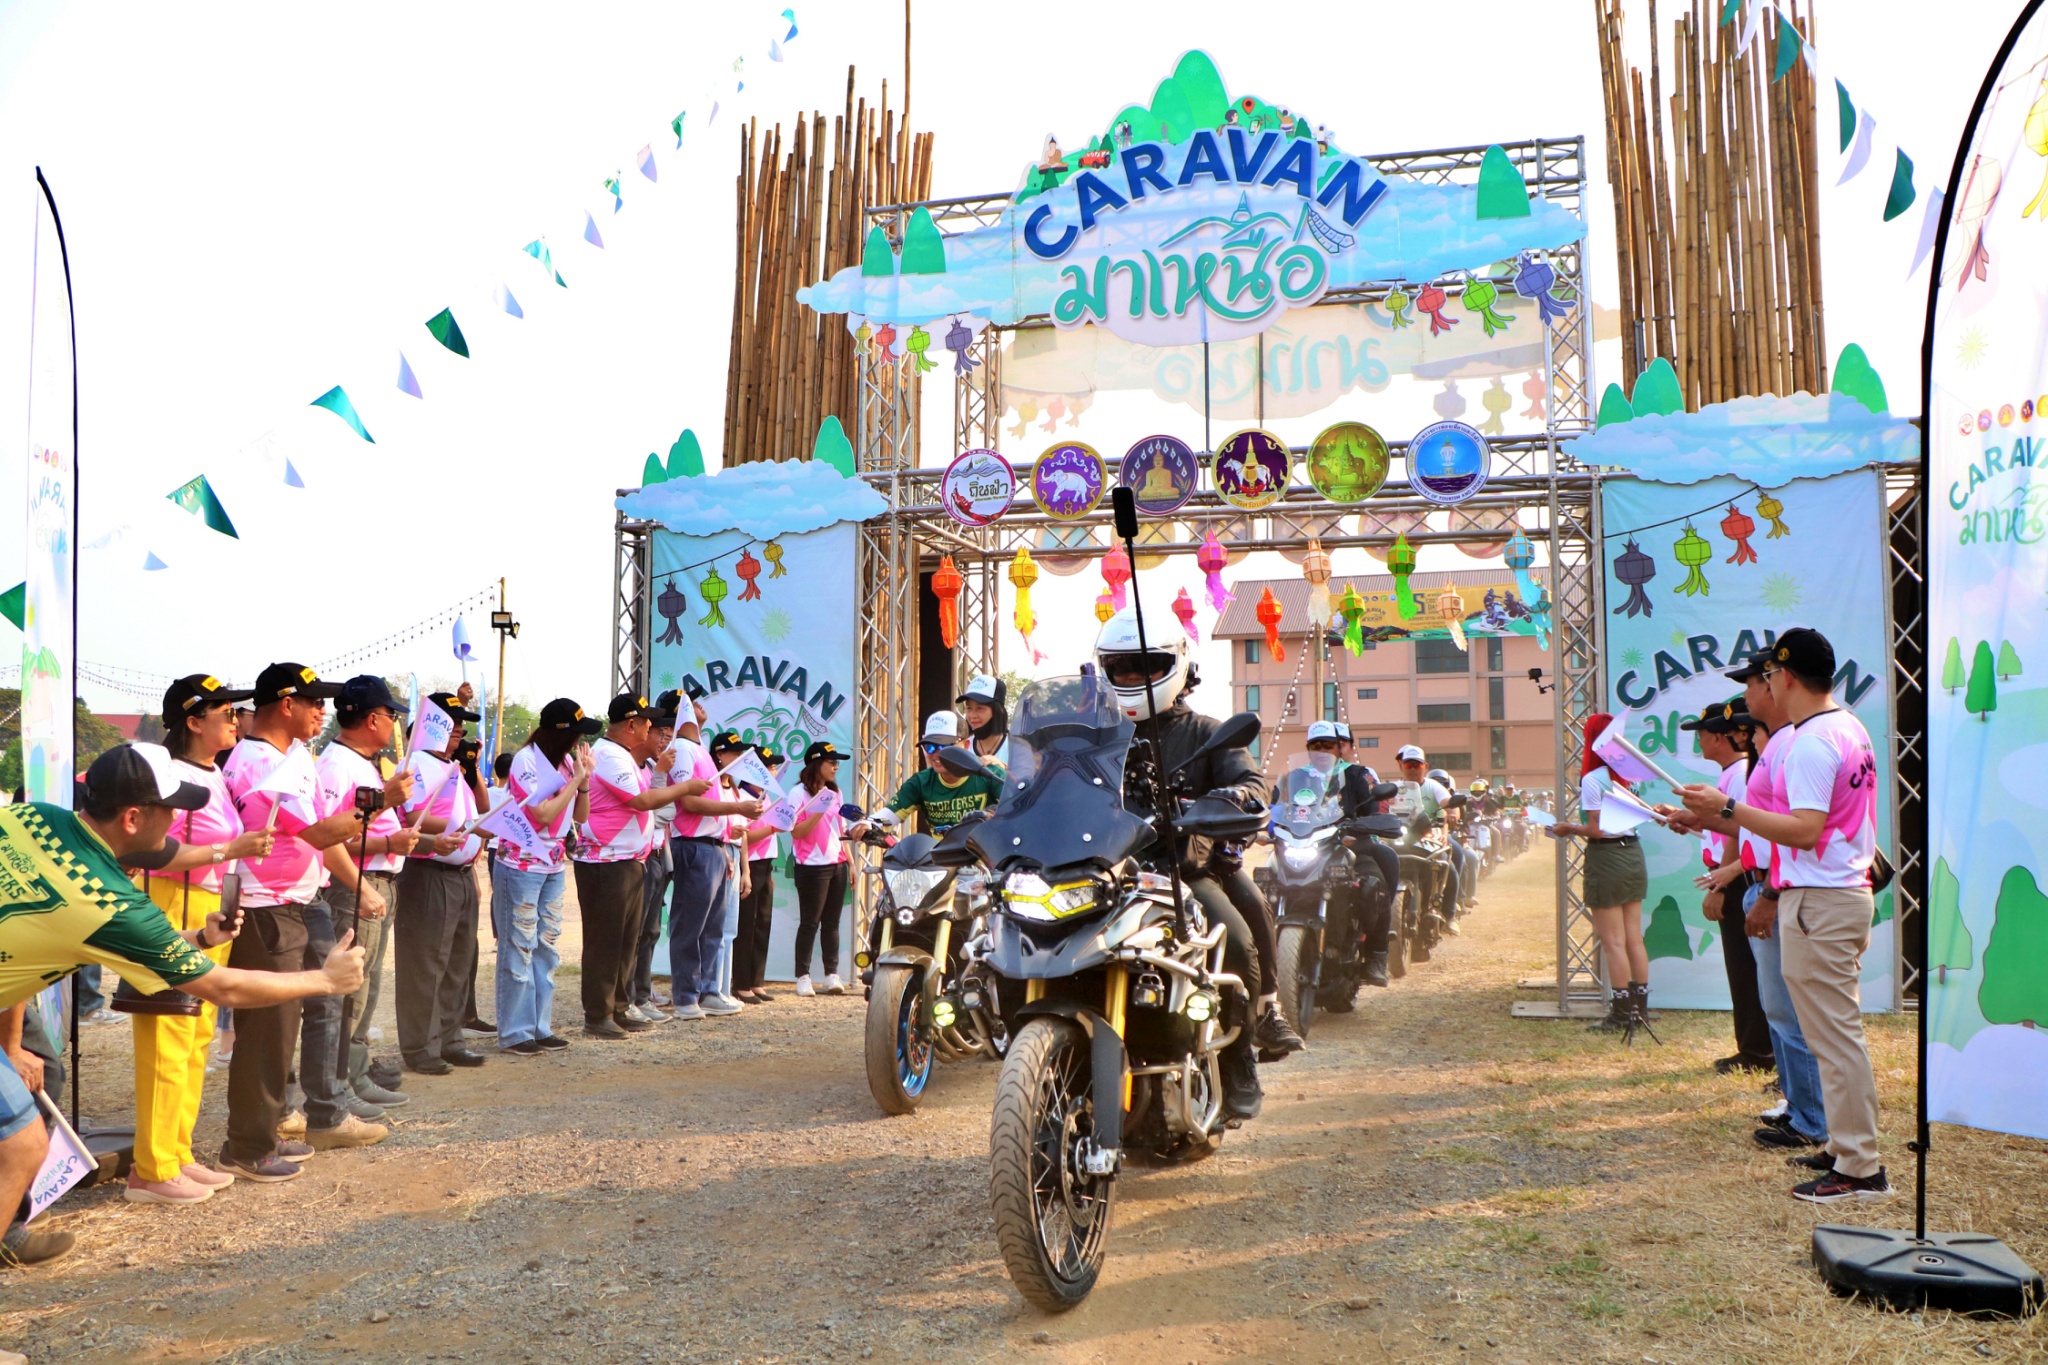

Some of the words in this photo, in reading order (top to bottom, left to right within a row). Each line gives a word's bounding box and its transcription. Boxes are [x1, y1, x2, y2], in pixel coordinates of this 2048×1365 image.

[1024, 128, 1388, 258] CARAVAN
[1055, 227, 1326, 323] มาเหนือ
[1949, 436, 2048, 511] CARAV
[655, 655, 845, 722] ARAVAN
[743, 758, 770, 786] CARAVAN
[502, 810, 533, 848] CARAVAN
[35, 1155, 78, 1205] CARAVA
